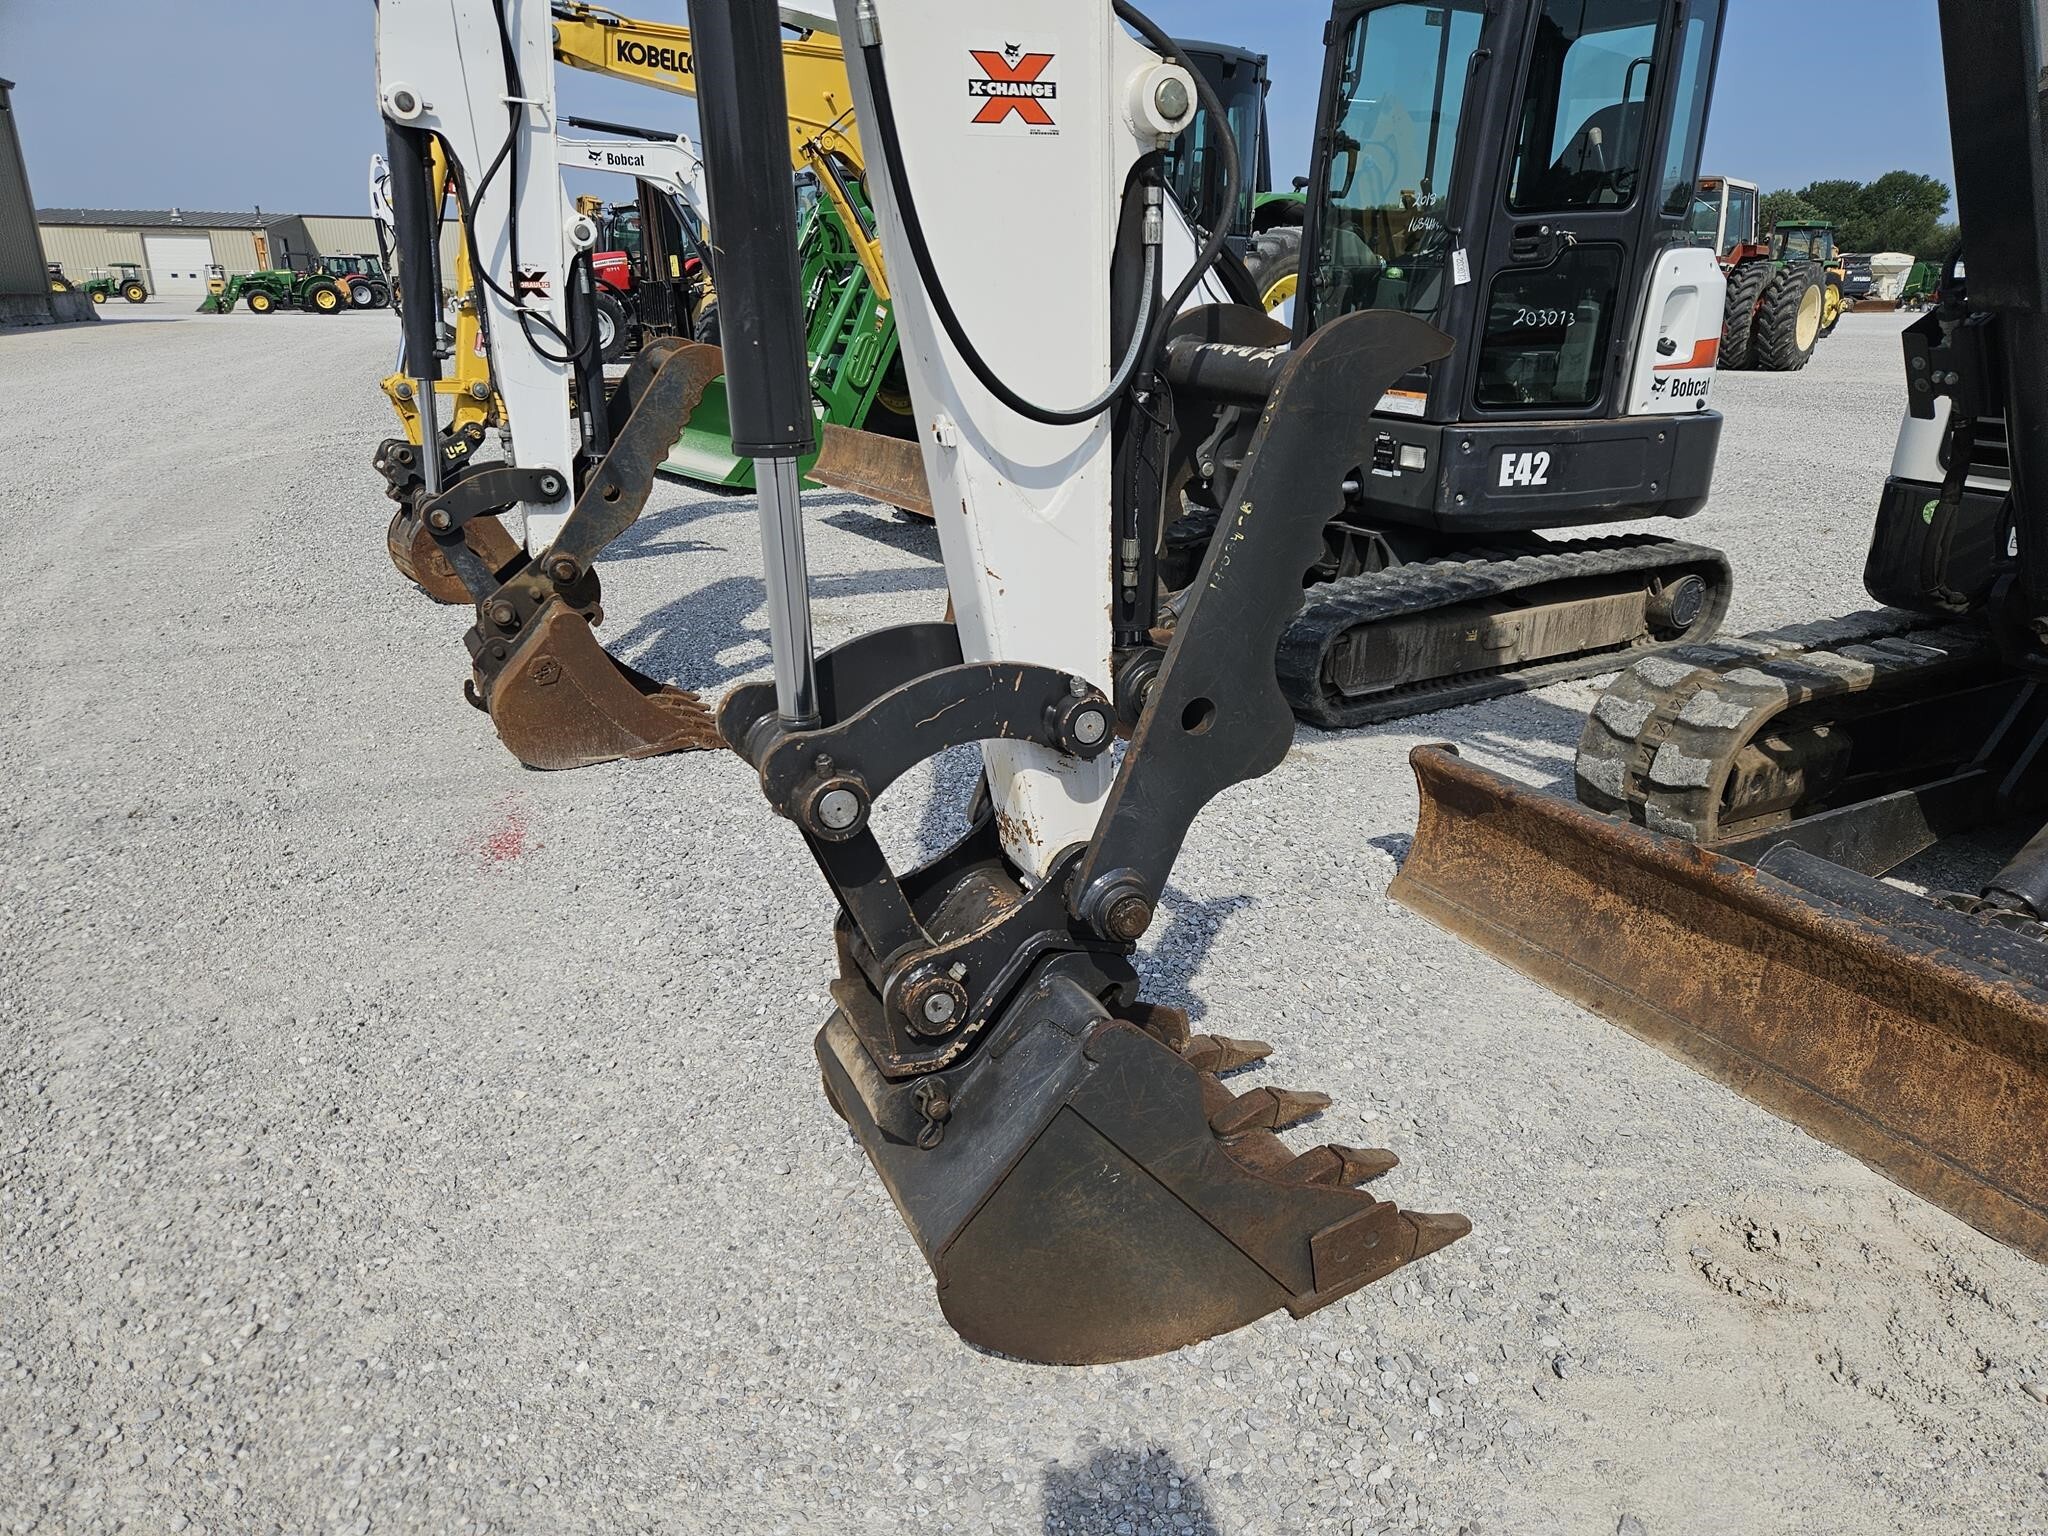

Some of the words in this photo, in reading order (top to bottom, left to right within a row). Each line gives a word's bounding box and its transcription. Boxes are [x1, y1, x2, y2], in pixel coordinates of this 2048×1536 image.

[970, 81, 1053, 97] X-CHANGE
[607, 153, 645, 166] Bobcat
[1412, 192, 1437, 208] 2018
[1671, 377, 1711, 397] Bobcat
[1499, 451, 1550, 487] E42
